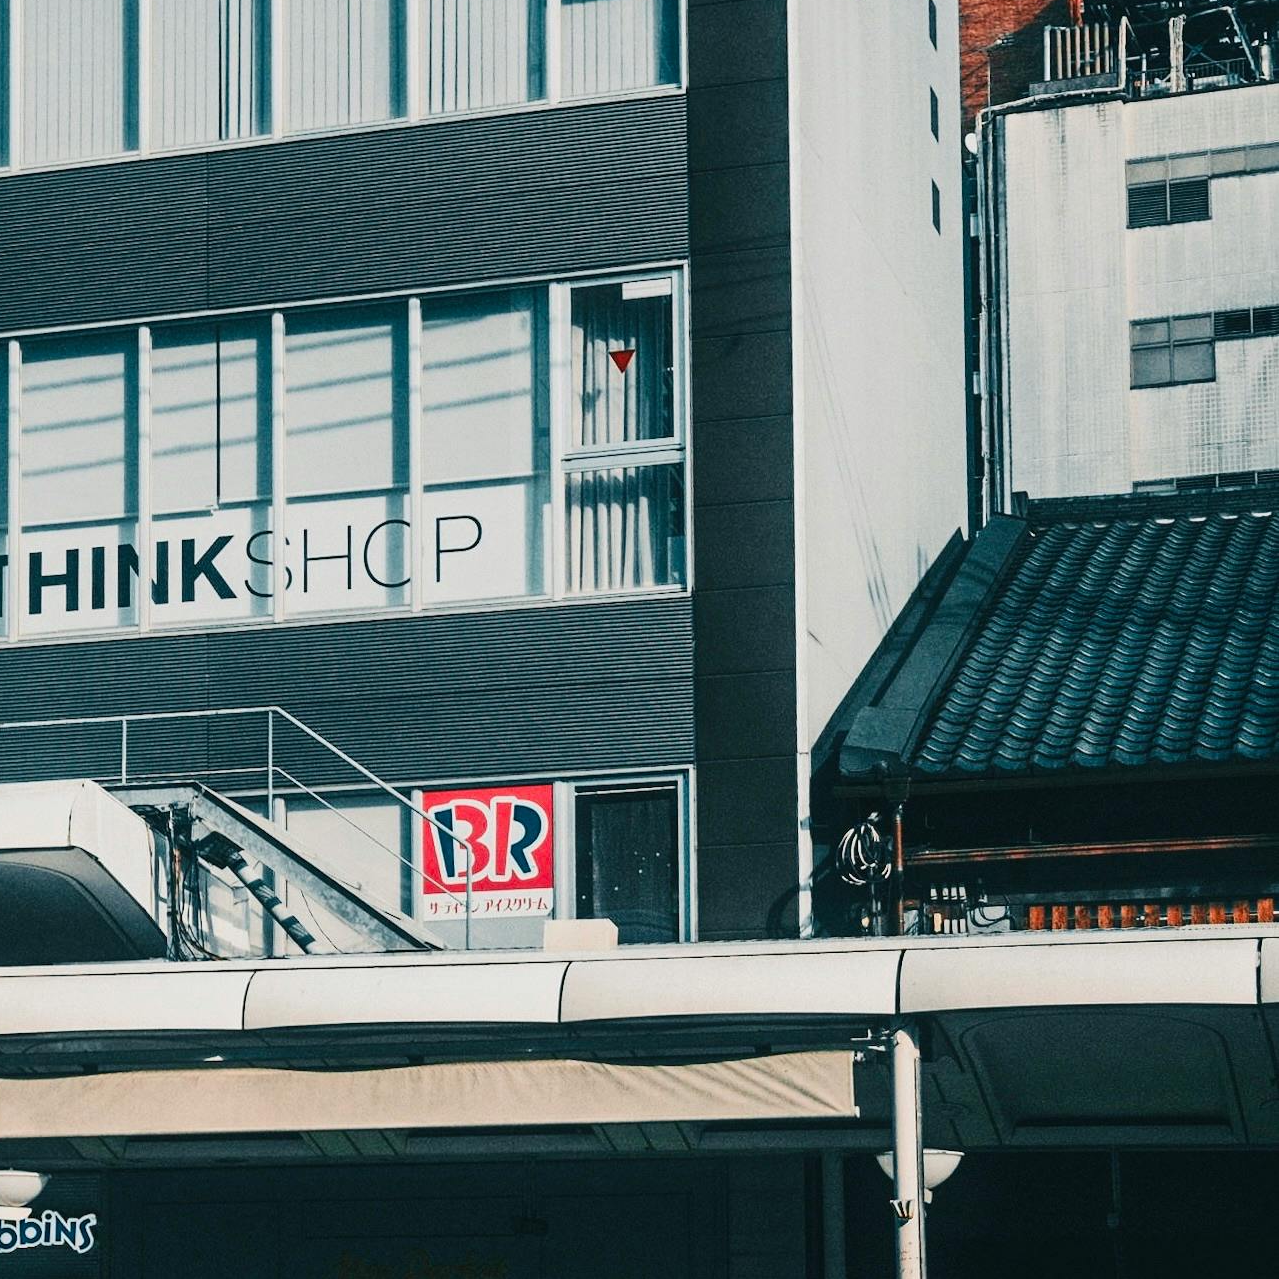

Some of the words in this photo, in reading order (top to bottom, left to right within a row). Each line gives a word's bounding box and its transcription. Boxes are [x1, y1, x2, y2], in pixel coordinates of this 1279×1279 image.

[428, 796, 549, 884] BR
[485, 896, 548, 913] アイスクリーム
